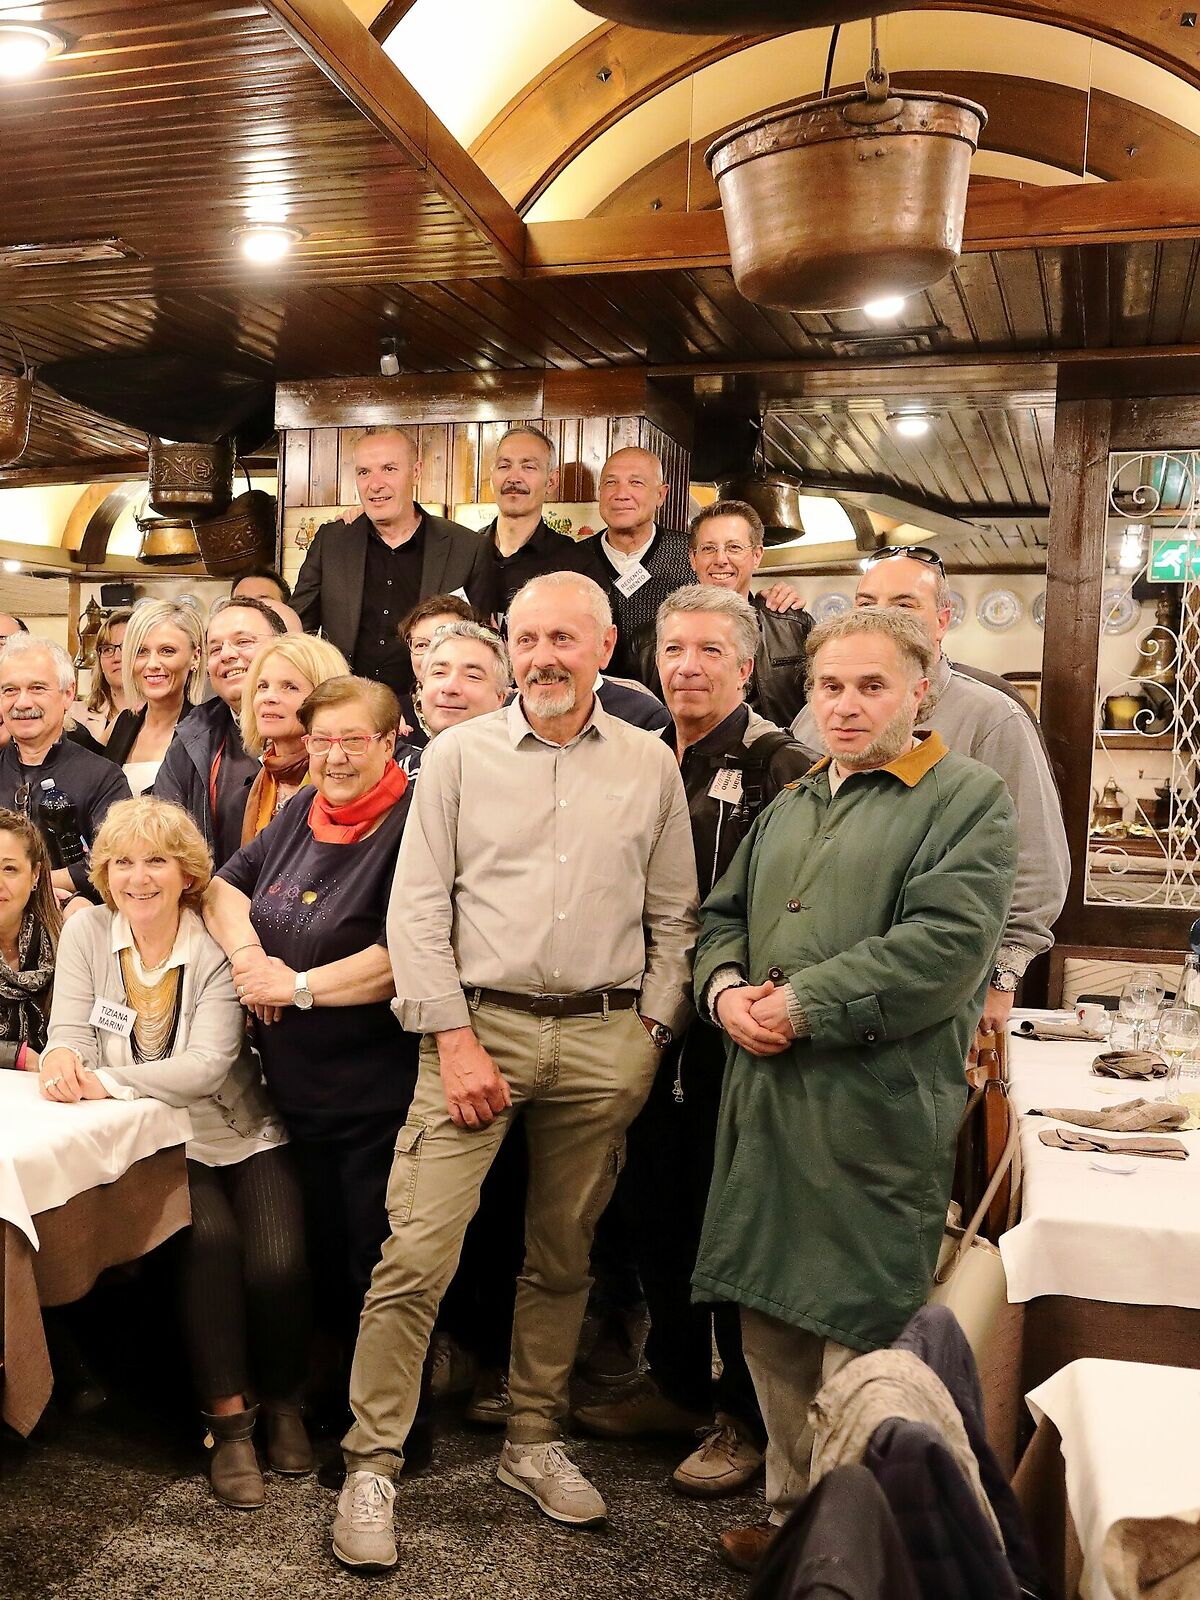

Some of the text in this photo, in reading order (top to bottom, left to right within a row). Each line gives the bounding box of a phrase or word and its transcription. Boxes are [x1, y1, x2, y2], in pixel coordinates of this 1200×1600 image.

[620, 568, 643, 589] REDENTO
[626, 574, 646, 592] TRENTO
[731, 772, 743, 790] Gian
[101, 1005, 128, 1022] TIZIANA
[98, 1016, 125, 1032] MARINI
